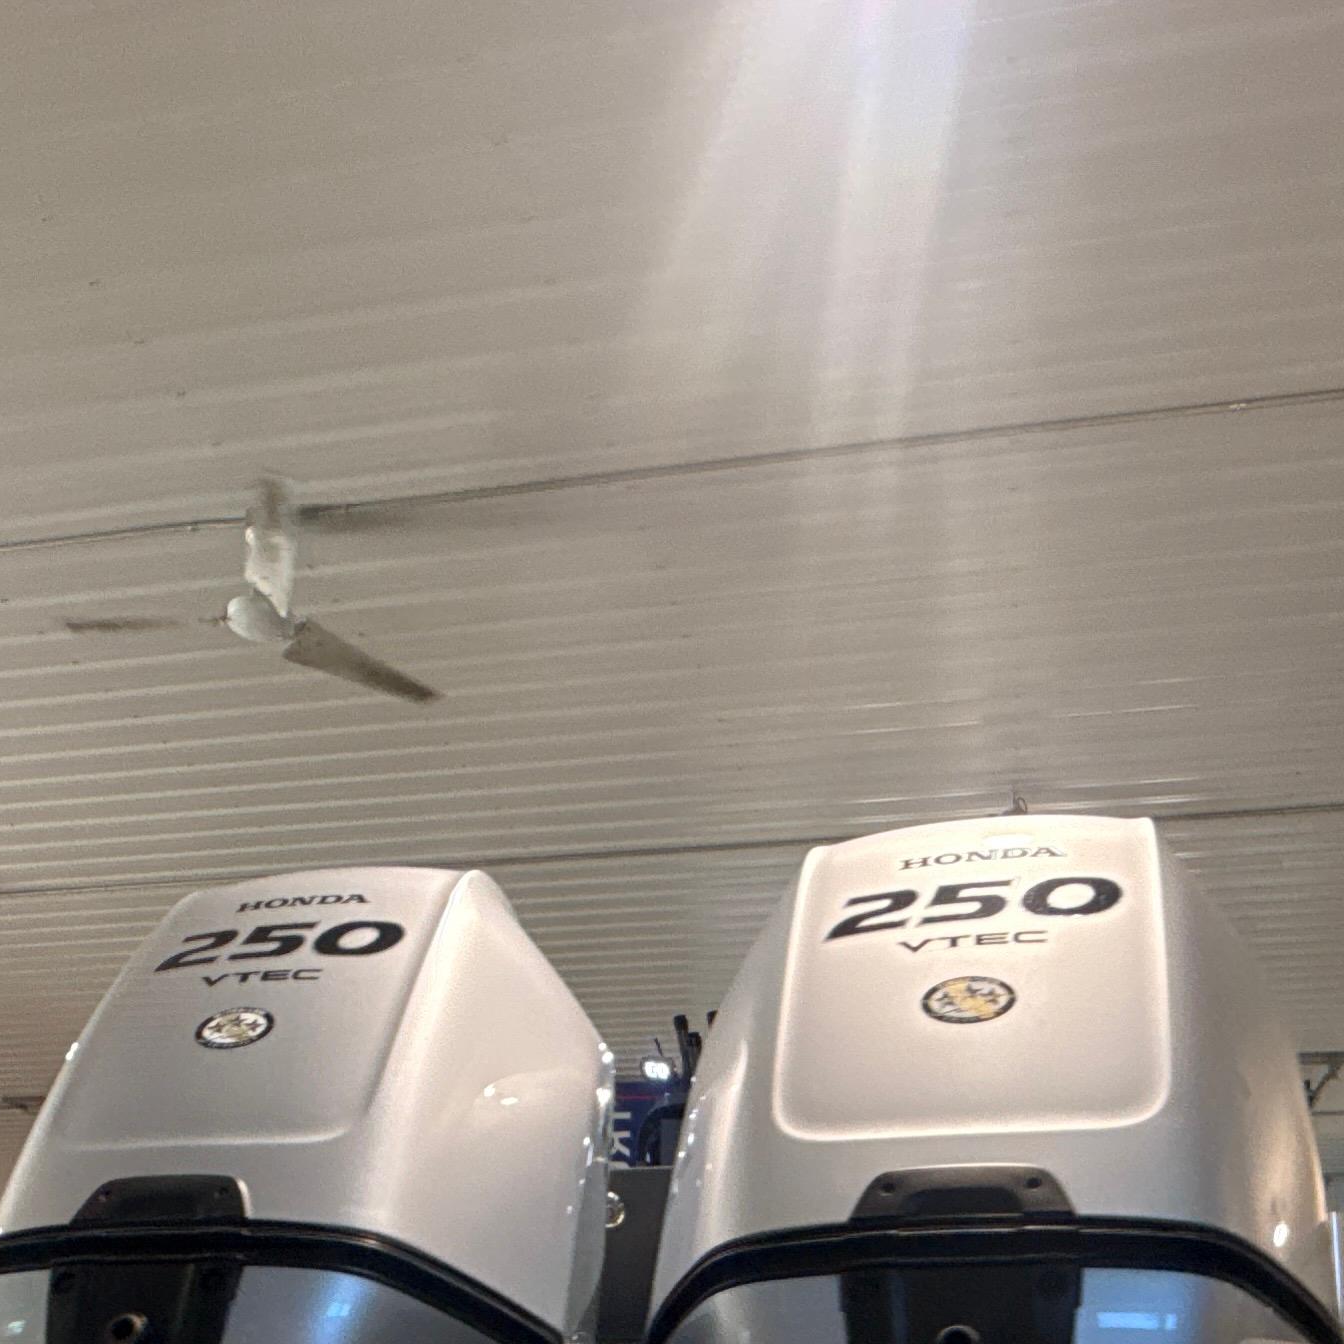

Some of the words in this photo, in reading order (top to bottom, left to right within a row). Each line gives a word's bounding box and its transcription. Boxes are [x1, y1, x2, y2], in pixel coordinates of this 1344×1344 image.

[897, 845, 1068, 871] HONDA
[235, 893, 369, 913] HONDA
[822, 876, 1123, 941] 250
[154, 920, 404, 972] 250
[897, 929, 1049, 953] VTEC
[202, 968, 324, 987] VTEC
